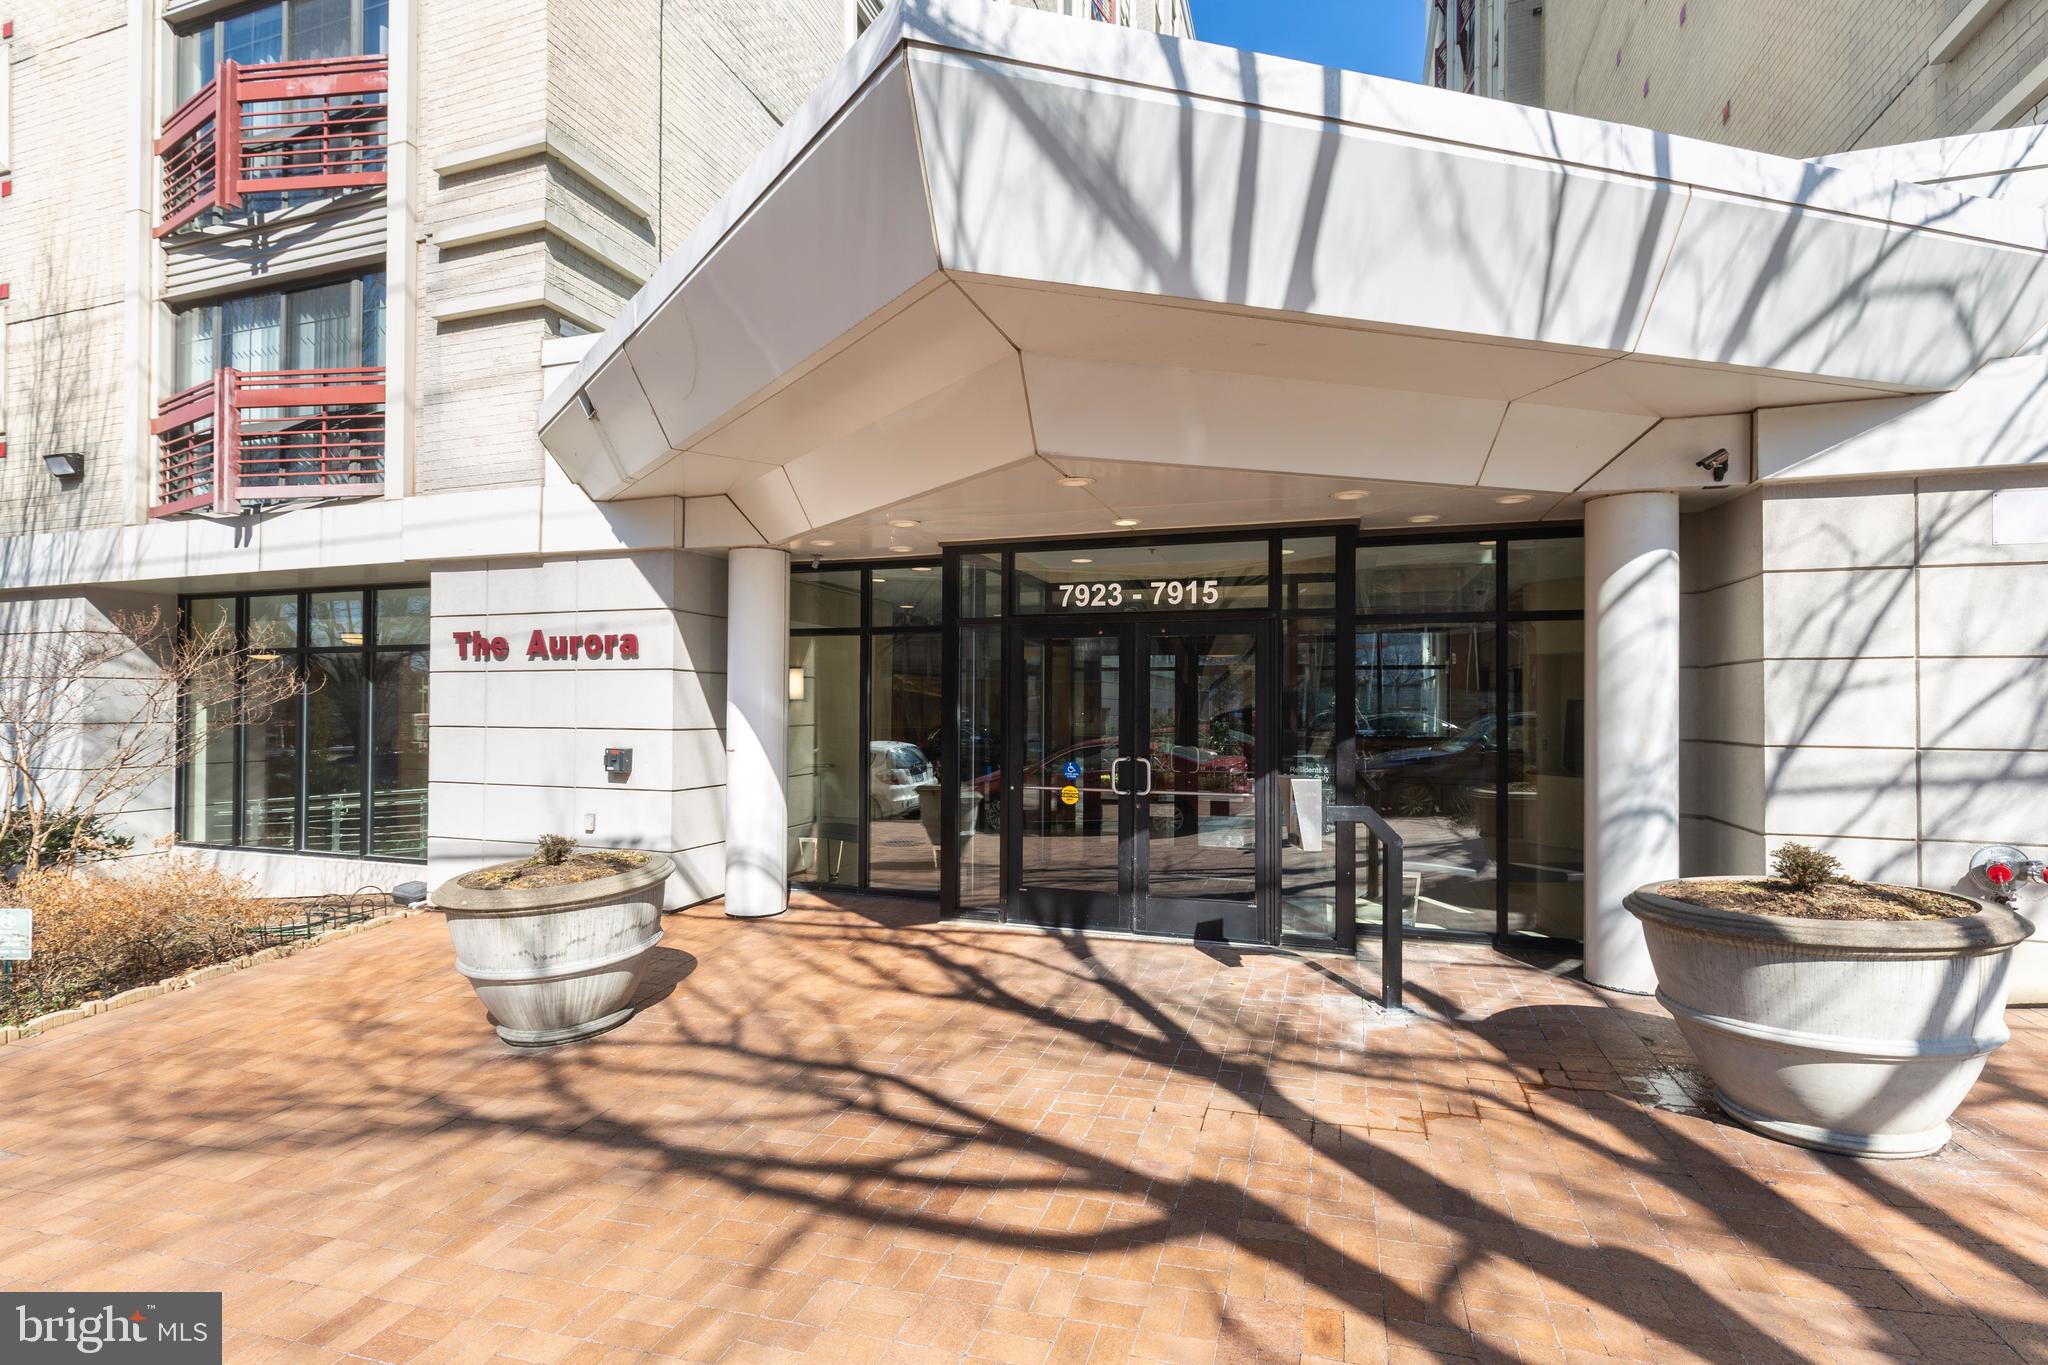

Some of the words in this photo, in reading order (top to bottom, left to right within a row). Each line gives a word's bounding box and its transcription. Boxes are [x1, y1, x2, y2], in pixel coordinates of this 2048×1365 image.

[1059, 583, 1123, 608] 7923
[1150, 580, 1219, 605] 7915
[453, 630, 509, 659] The
[526, 629, 639, 659] Aurora
